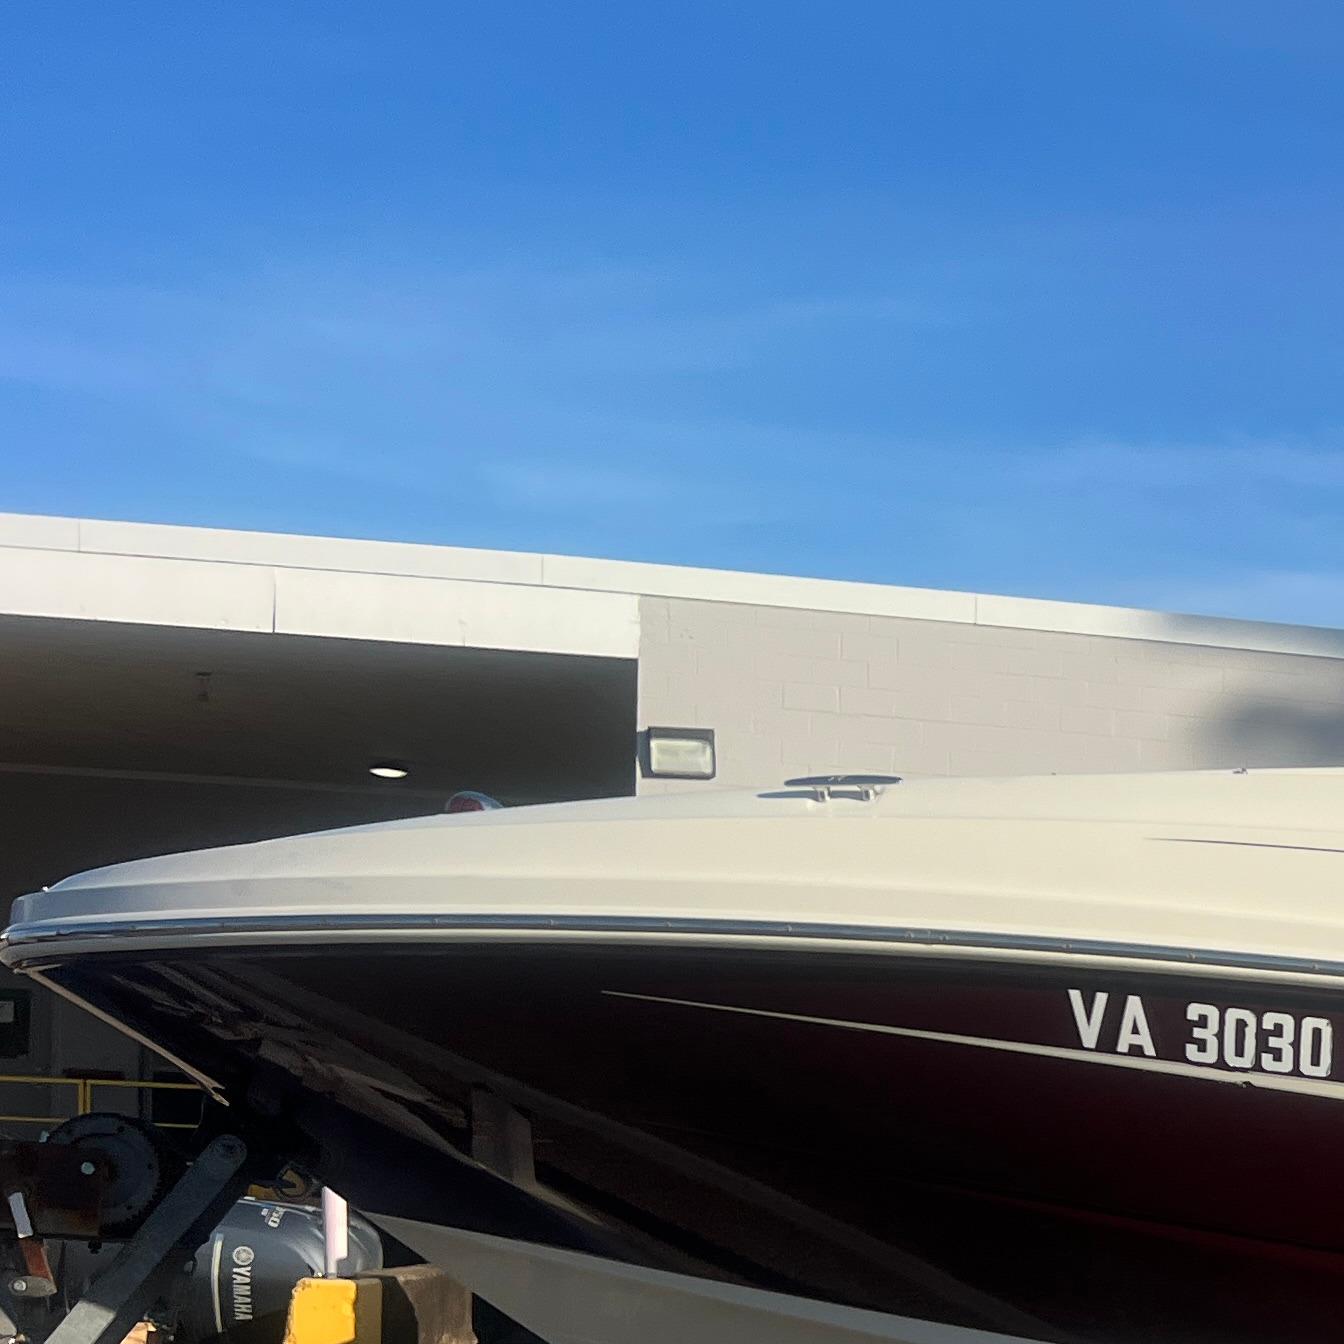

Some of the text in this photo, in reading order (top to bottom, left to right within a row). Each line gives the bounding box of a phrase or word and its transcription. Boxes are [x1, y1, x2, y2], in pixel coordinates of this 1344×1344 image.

[1067, 988, 1157, 1058] VA
[1185, 1002, 1333, 1078] 3030
[232, 1266, 253, 1320] YAMAHA
